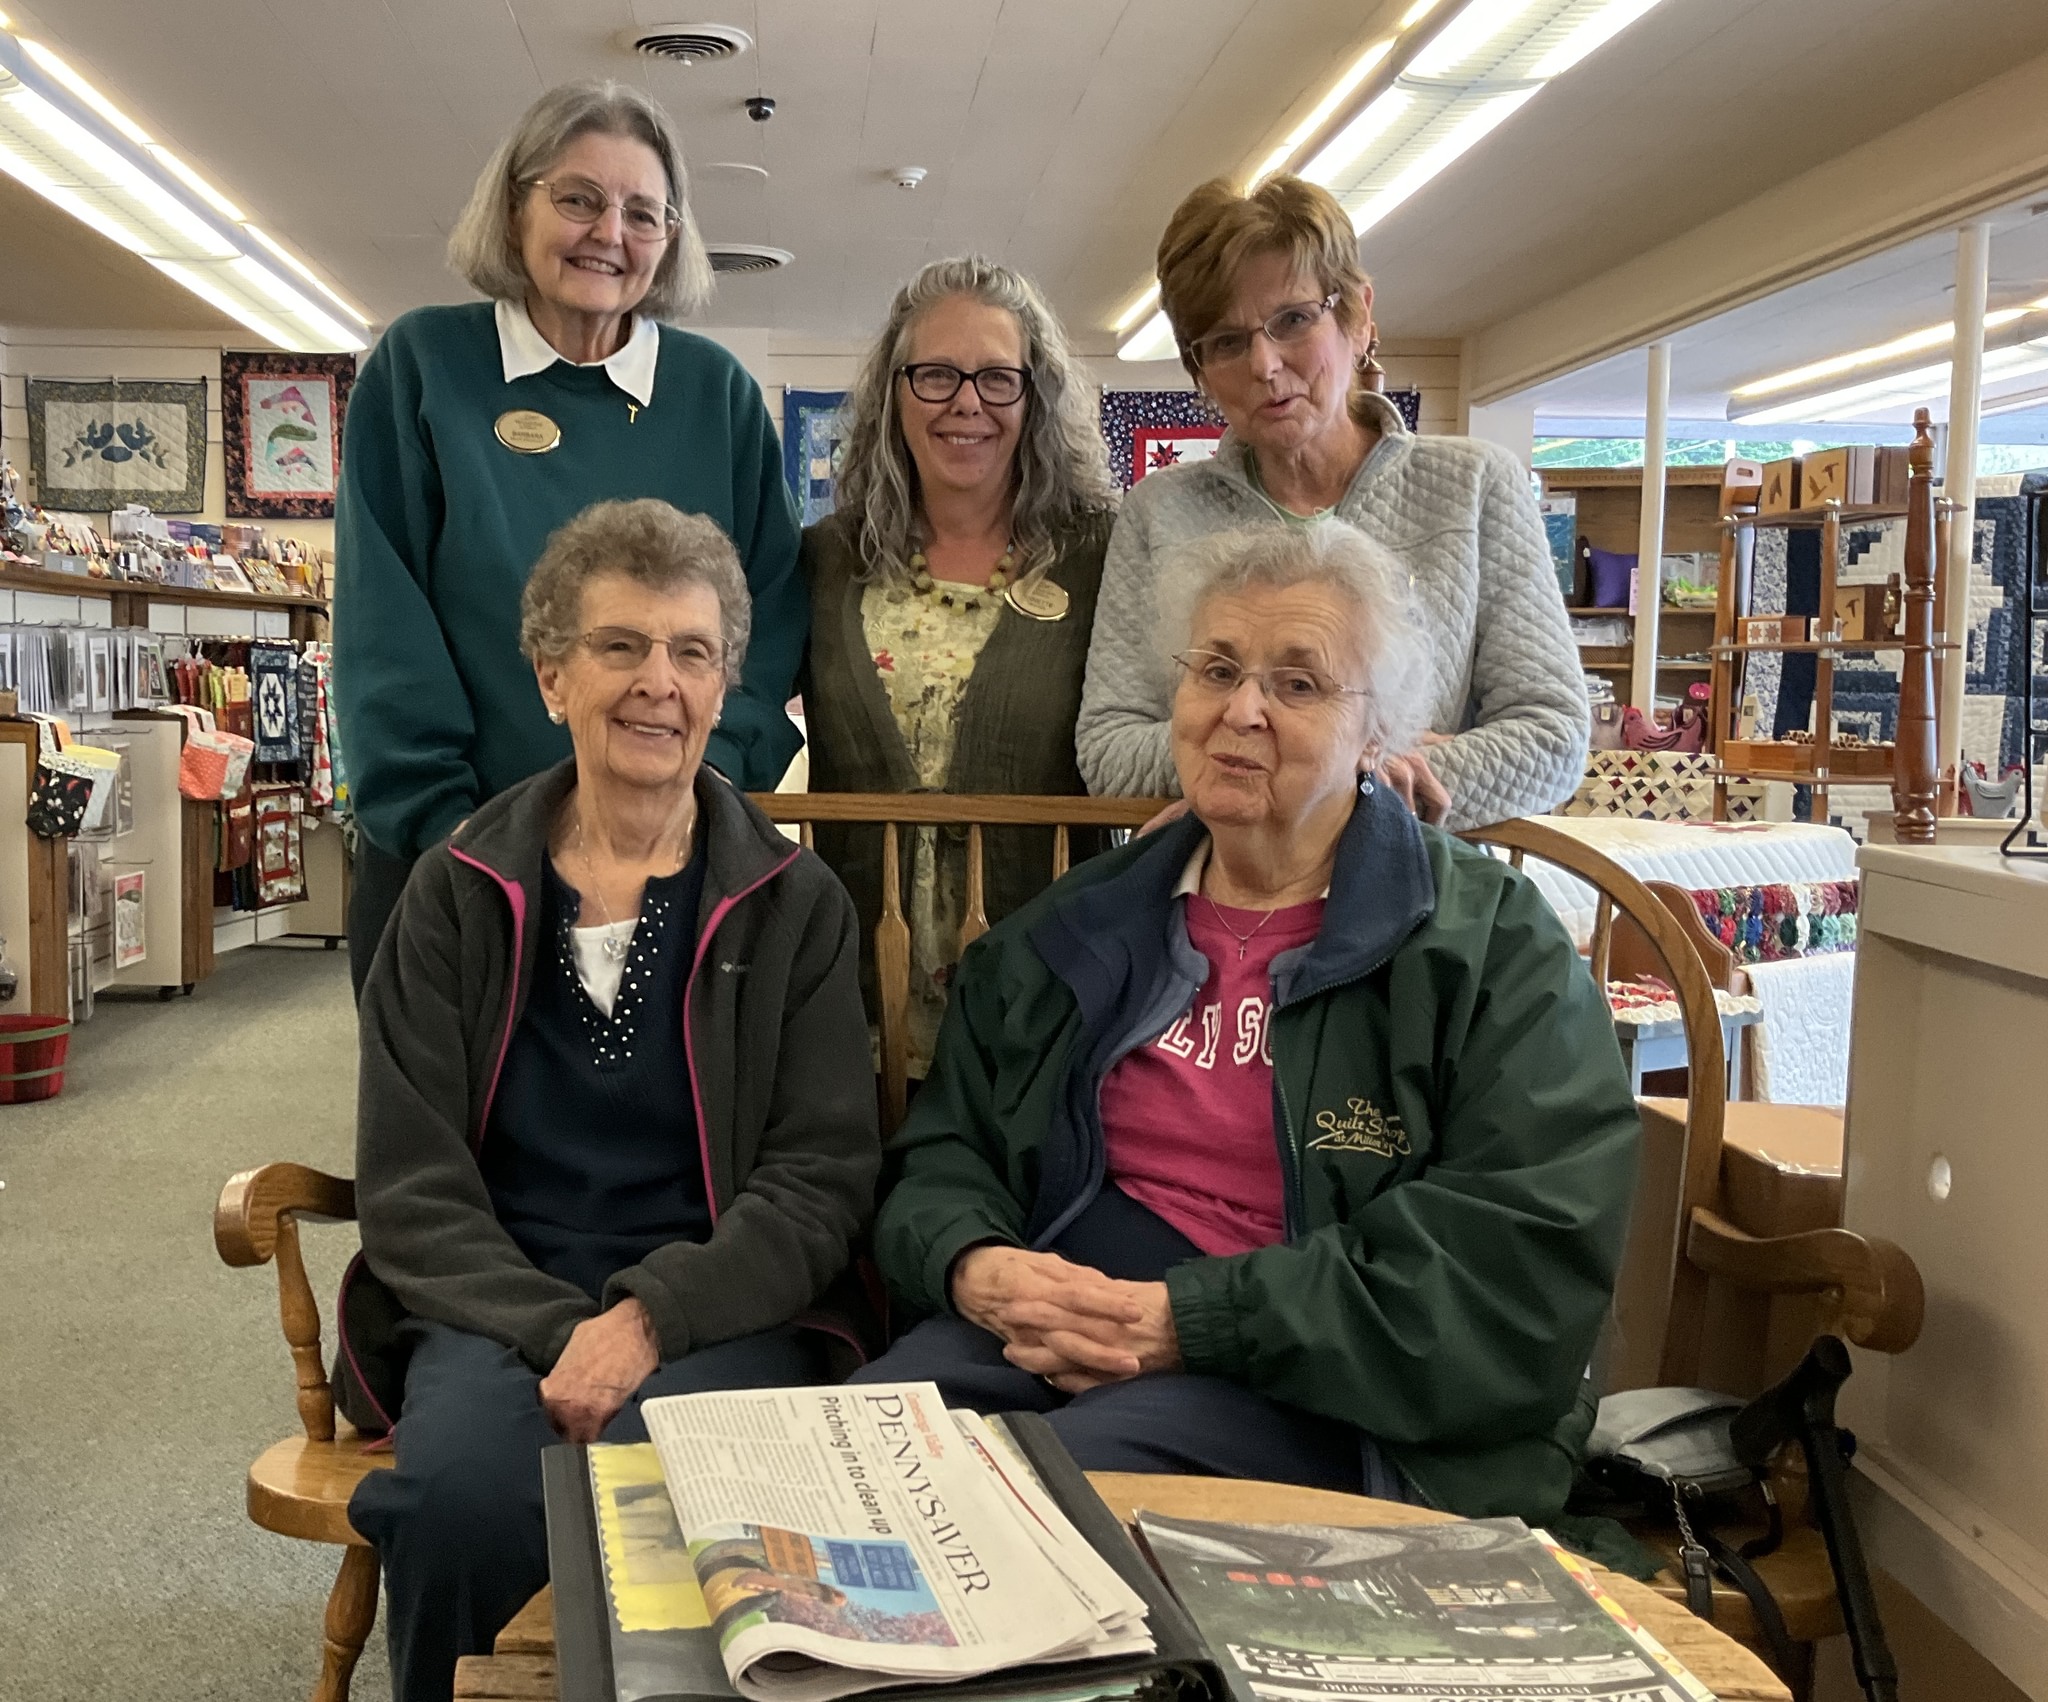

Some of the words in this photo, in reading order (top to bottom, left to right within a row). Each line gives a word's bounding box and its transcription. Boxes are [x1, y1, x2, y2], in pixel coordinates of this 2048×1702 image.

[1347, 1098, 1380, 1117] The
[1315, 1110, 1365, 1133] Quilt
[1366, 1117, 1407, 1145] Shop
[1334, 1133, 1346, 1143] at
[818, 1396, 853, 1449] Pitching
[840, 1451, 862, 1469] in
[847, 1465, 867, 1480] to
[856, 1479, 883, 1521] clean
[864, 1393, 991, 1596] PENNYSAVER
[868, 1517, 893, 1535] up
[1317, 1682, 1388, 1695] INSPIRE
[1402, 1684, 1504, 1696] EXCHANGE
[1517, 1685, 1591, 1696] INFORM
